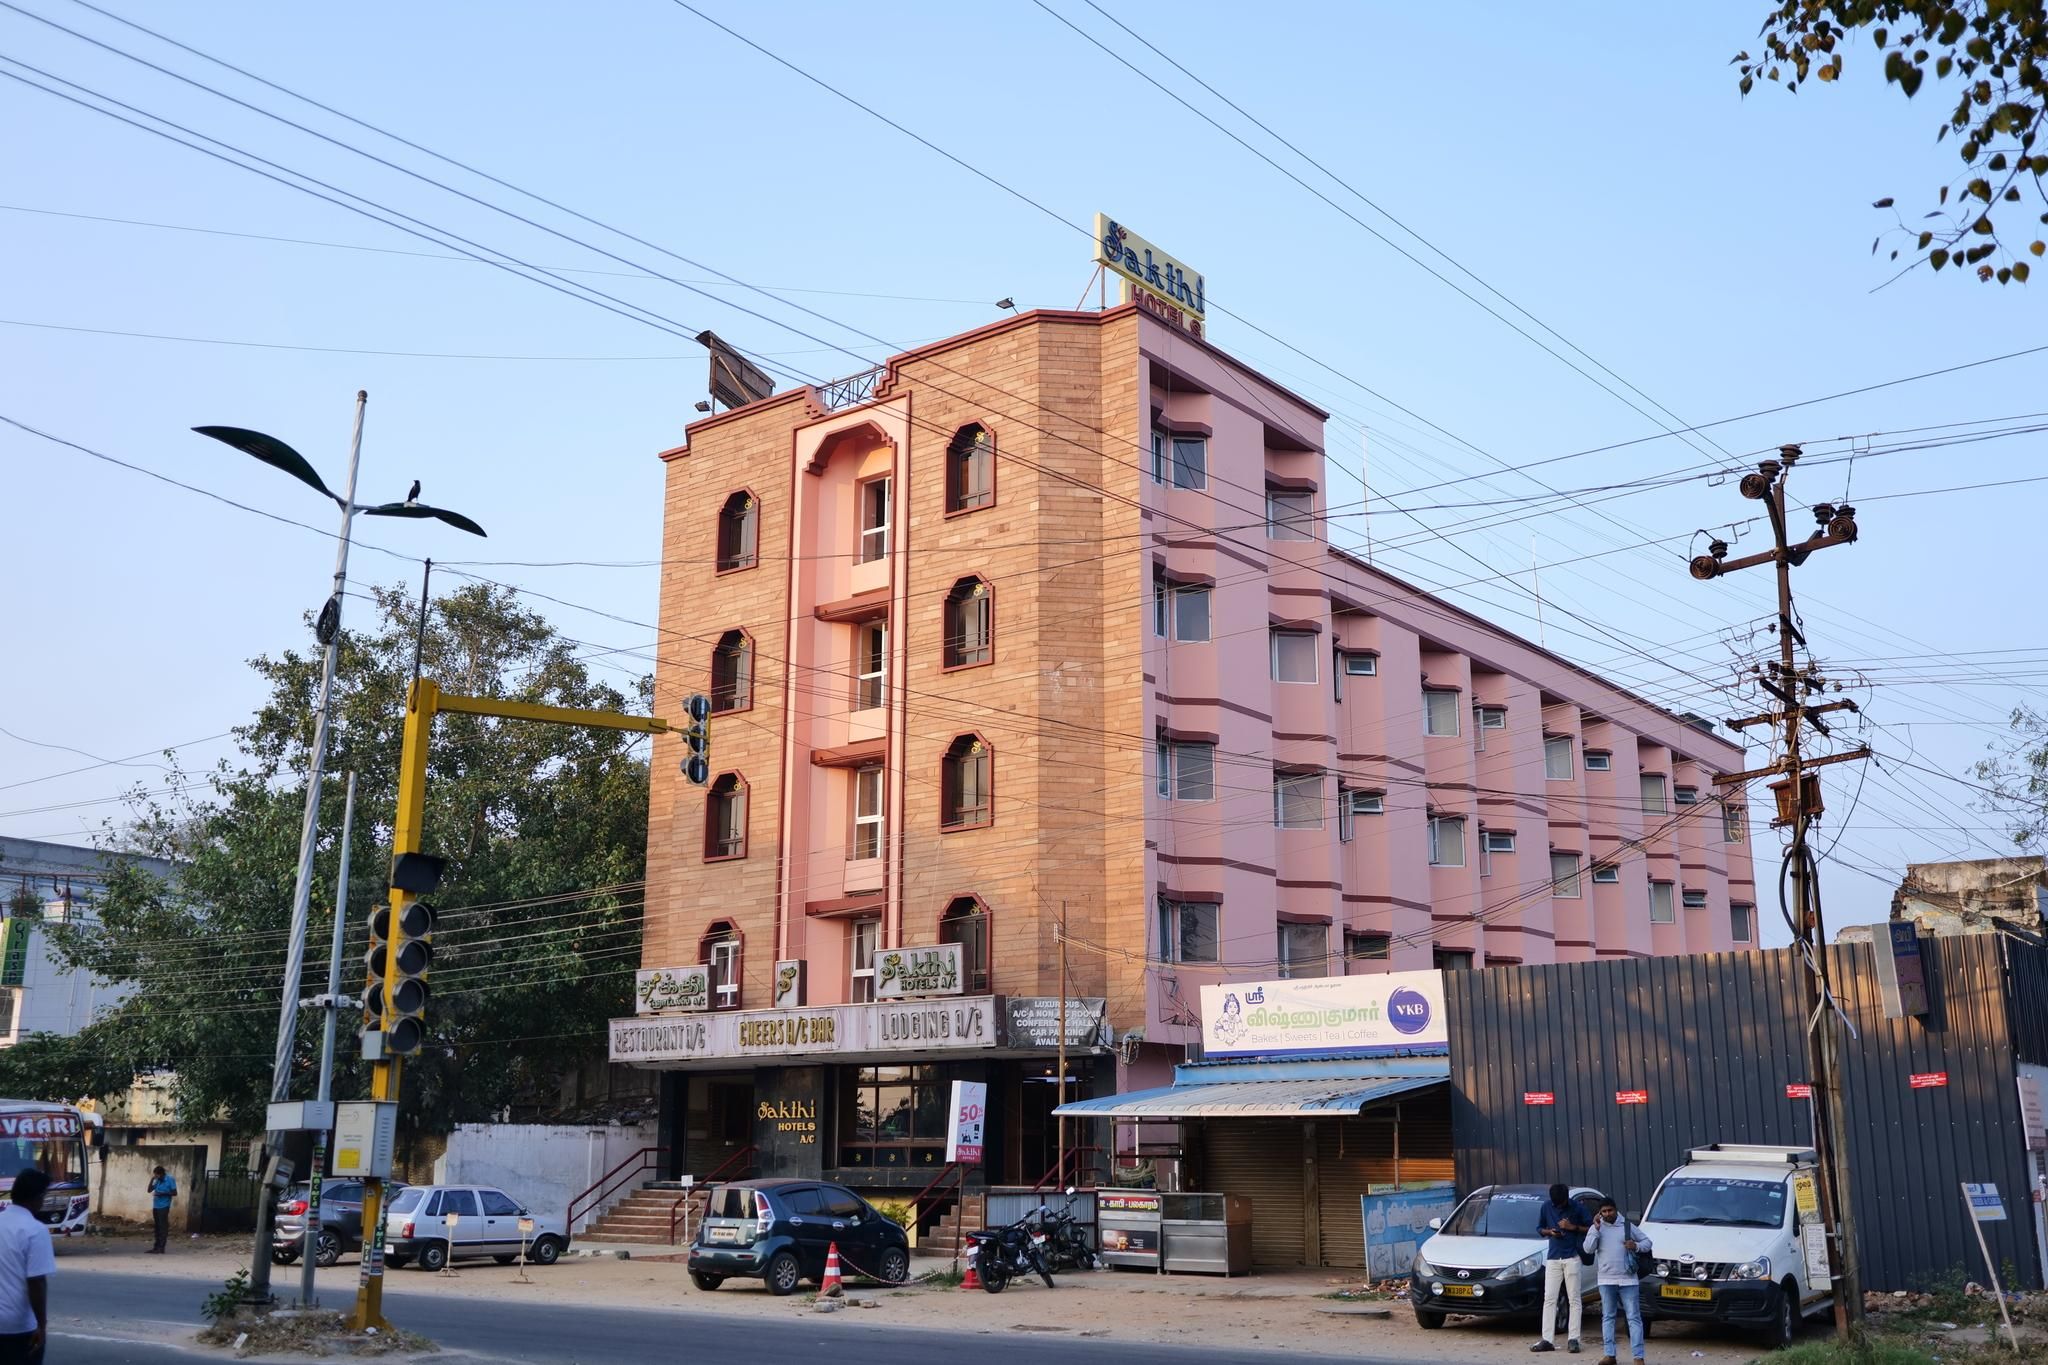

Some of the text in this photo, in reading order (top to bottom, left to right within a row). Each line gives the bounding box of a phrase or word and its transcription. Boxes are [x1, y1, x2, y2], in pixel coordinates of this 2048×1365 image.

[1103, 220, 1205, 314] Sakthi
[879, 951, 957, 989] Sakthi
[900, 975, 957, 991] HOTELS A/C
[1396, 1004, 1424, 1016] VKB
[881, 1007, 983, 1040] LODGING A/C
[1016, 1019, 1071, 1027] CONFERENE
[614, 1023, 705, 1052] RESTAURANT A/C
[739, 1016, 834, 1046] CHEERS A/C BAR
[1030, 1028, 1084, 1036] CAR PAKING
[1251, 1029, 1378, 1043] Bakes Sweets Tea Coffee
[1035, 1038, 1079, 1046] AVAILBLE
[758, 1099, 815, 1120] Sakthi
[778, 1122, 816, 1131] HOTELS
[800, 1134, 815, 1144] A/C
